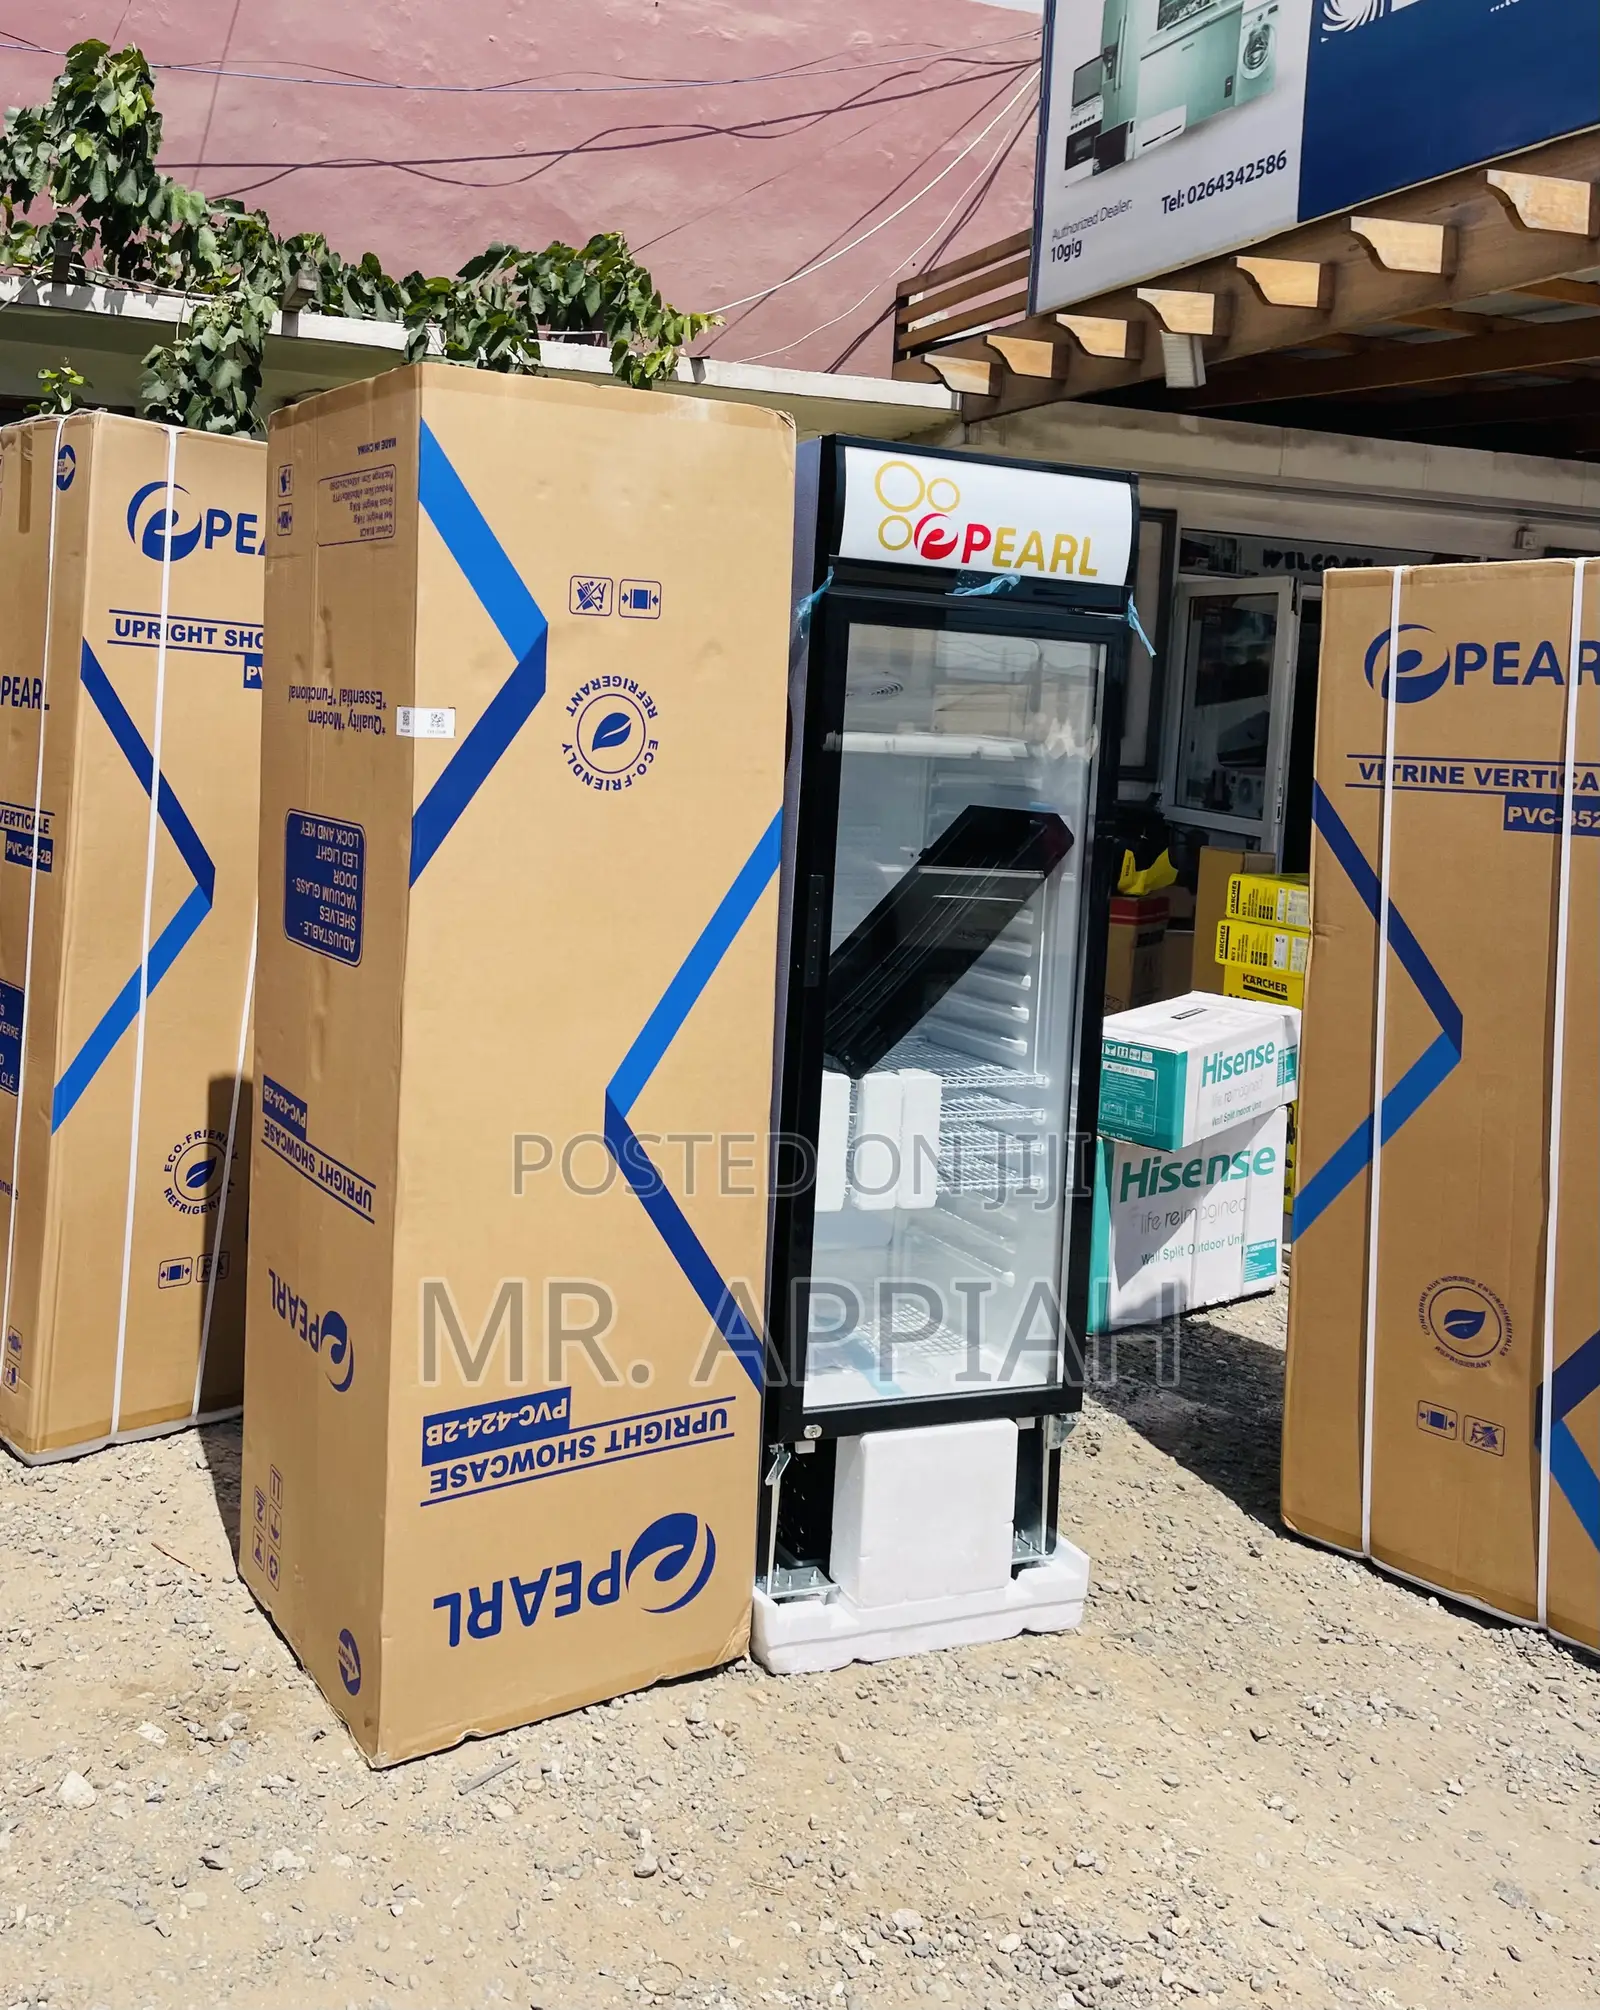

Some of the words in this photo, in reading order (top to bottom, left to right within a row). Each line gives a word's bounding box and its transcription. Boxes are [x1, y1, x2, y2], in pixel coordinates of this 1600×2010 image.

[1161, 188, 1186, 214] Tel:
[1187, 150, 1288, 205] 0264342586
[1051, 212, 1099, 242] Authorized
[1050, 238, 1083, 263] 10gig
[961, 522, 1098, 577] PEARL
[115, 618, 218, 645] UPRIGHT
[0, 675, 50, 711] PEAR
[565, 675, 659, 719] REFRIGERANT
[561, 739, 659, 792] ECO-FRIENDLY
[1359, 762, 1465, 785] VITRINE
[300, 821, 316, 837] KEY
[317, 825, 336, 842] AND
[336, 829, 359, 849] LOCK
[6, 840, 52, 865] PVC-42-2B
[316, 844, 341, 863] LIGHT
[342, 851, 359, 869] LED
[333, 869, 358, 890] DOOR
[322, 885, 357, 911] VACUUM
[319, 905, 356, 932] SHELVES
[1201, 1041, 1275, 1088] Hisense
[263, 1084, 307, 1129] PVC-424-2B
[263, 1119, 316, 1173] SHOWCASE
[317, 1161, 372, 1213] UPRIGHT
[1119, 1146, 1276, 1203] Hisense
[1141, 1211, 1161, 1235] life
[1141, 1249, 1160, 1266] Wall
[1163, 1246, 1184, 1262] Split
[268, 1268, 320, 1353] PEARL
[425, 1397, 568, 1447] PVC-424-2B
[604, 1408, 728, 1454] UPRIGHT
[429, 1435, 596, 1494] SHOWCASE
[433, 1549, 622, 1648] PEARL
